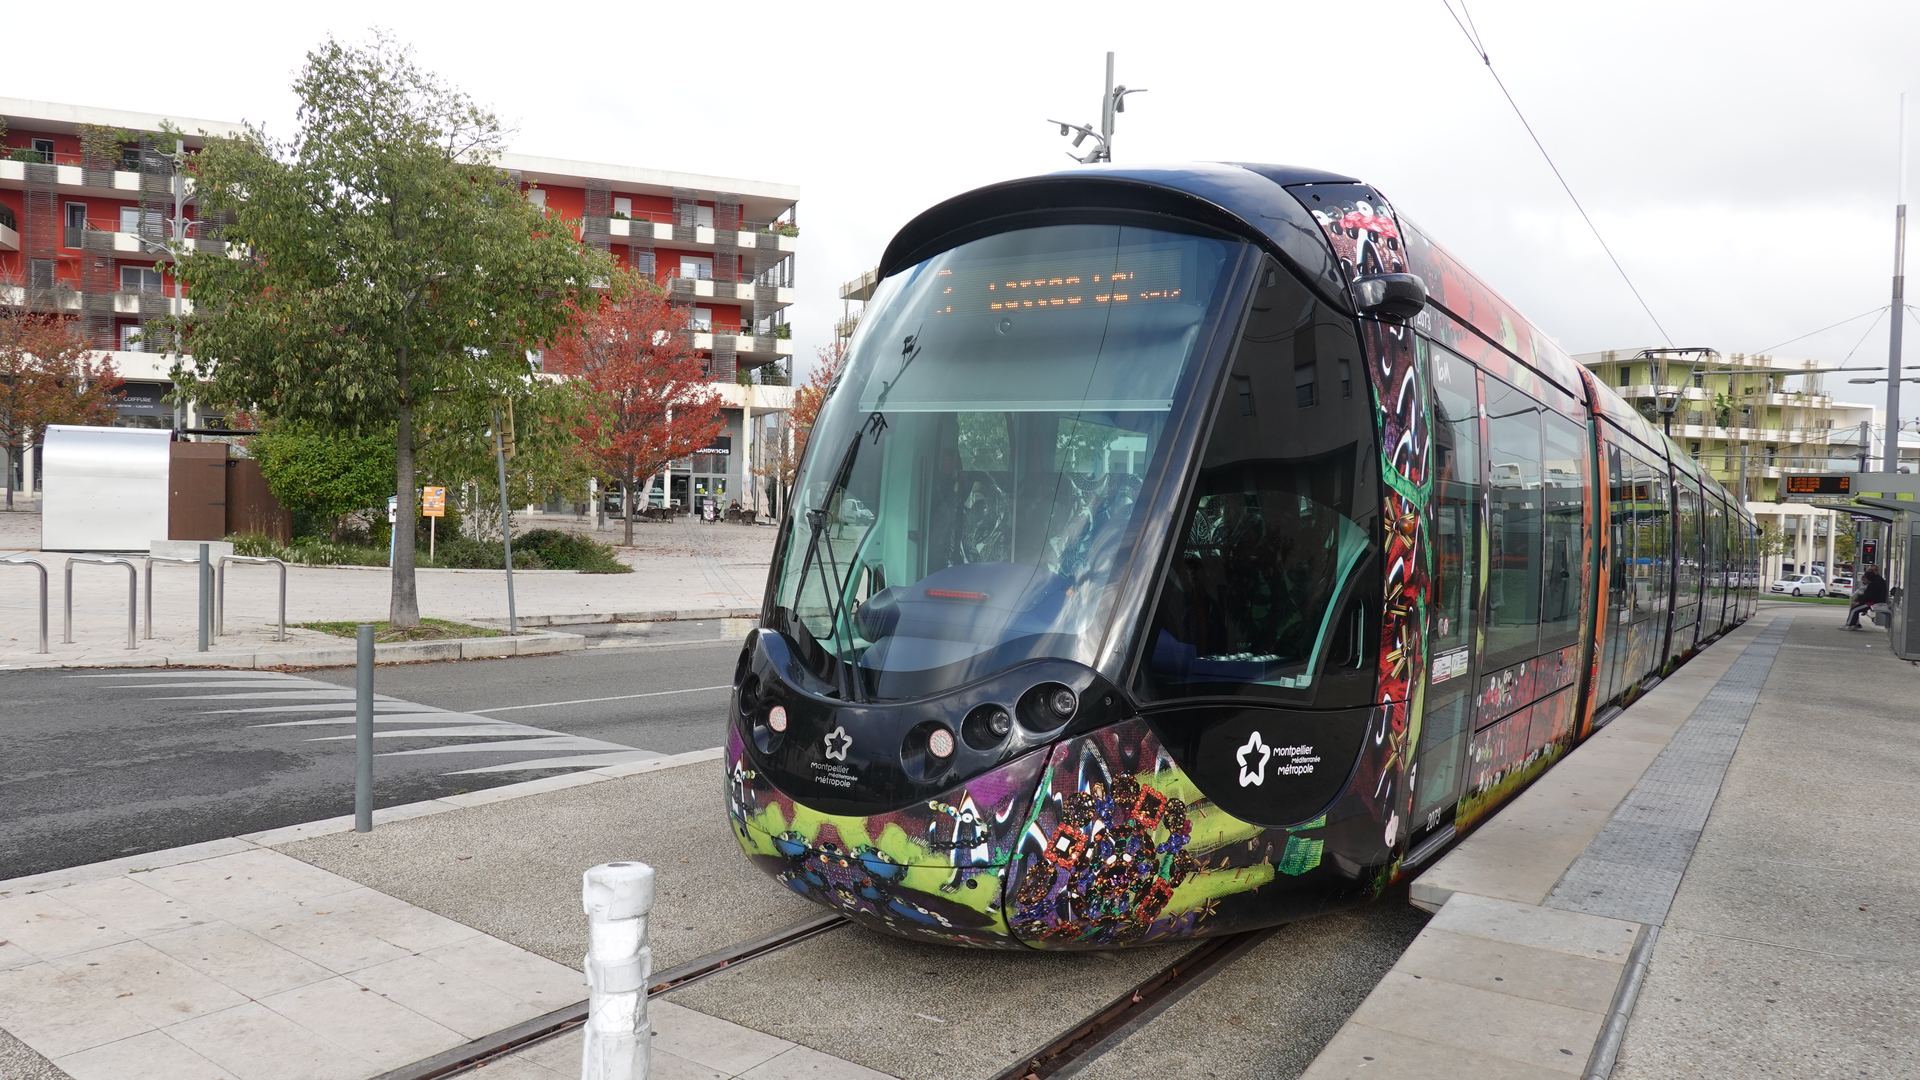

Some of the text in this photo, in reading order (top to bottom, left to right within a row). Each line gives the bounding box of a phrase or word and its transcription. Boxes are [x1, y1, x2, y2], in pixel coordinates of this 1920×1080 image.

[1273, 745, 1313, 757] Montpellier
[810, 762, 849, 774] Montpellier
[1277, 764, 1314, 776] Métropole
[815, 776, 851, 788] Métropole
[1426, 807, 1441, 831] 2073
